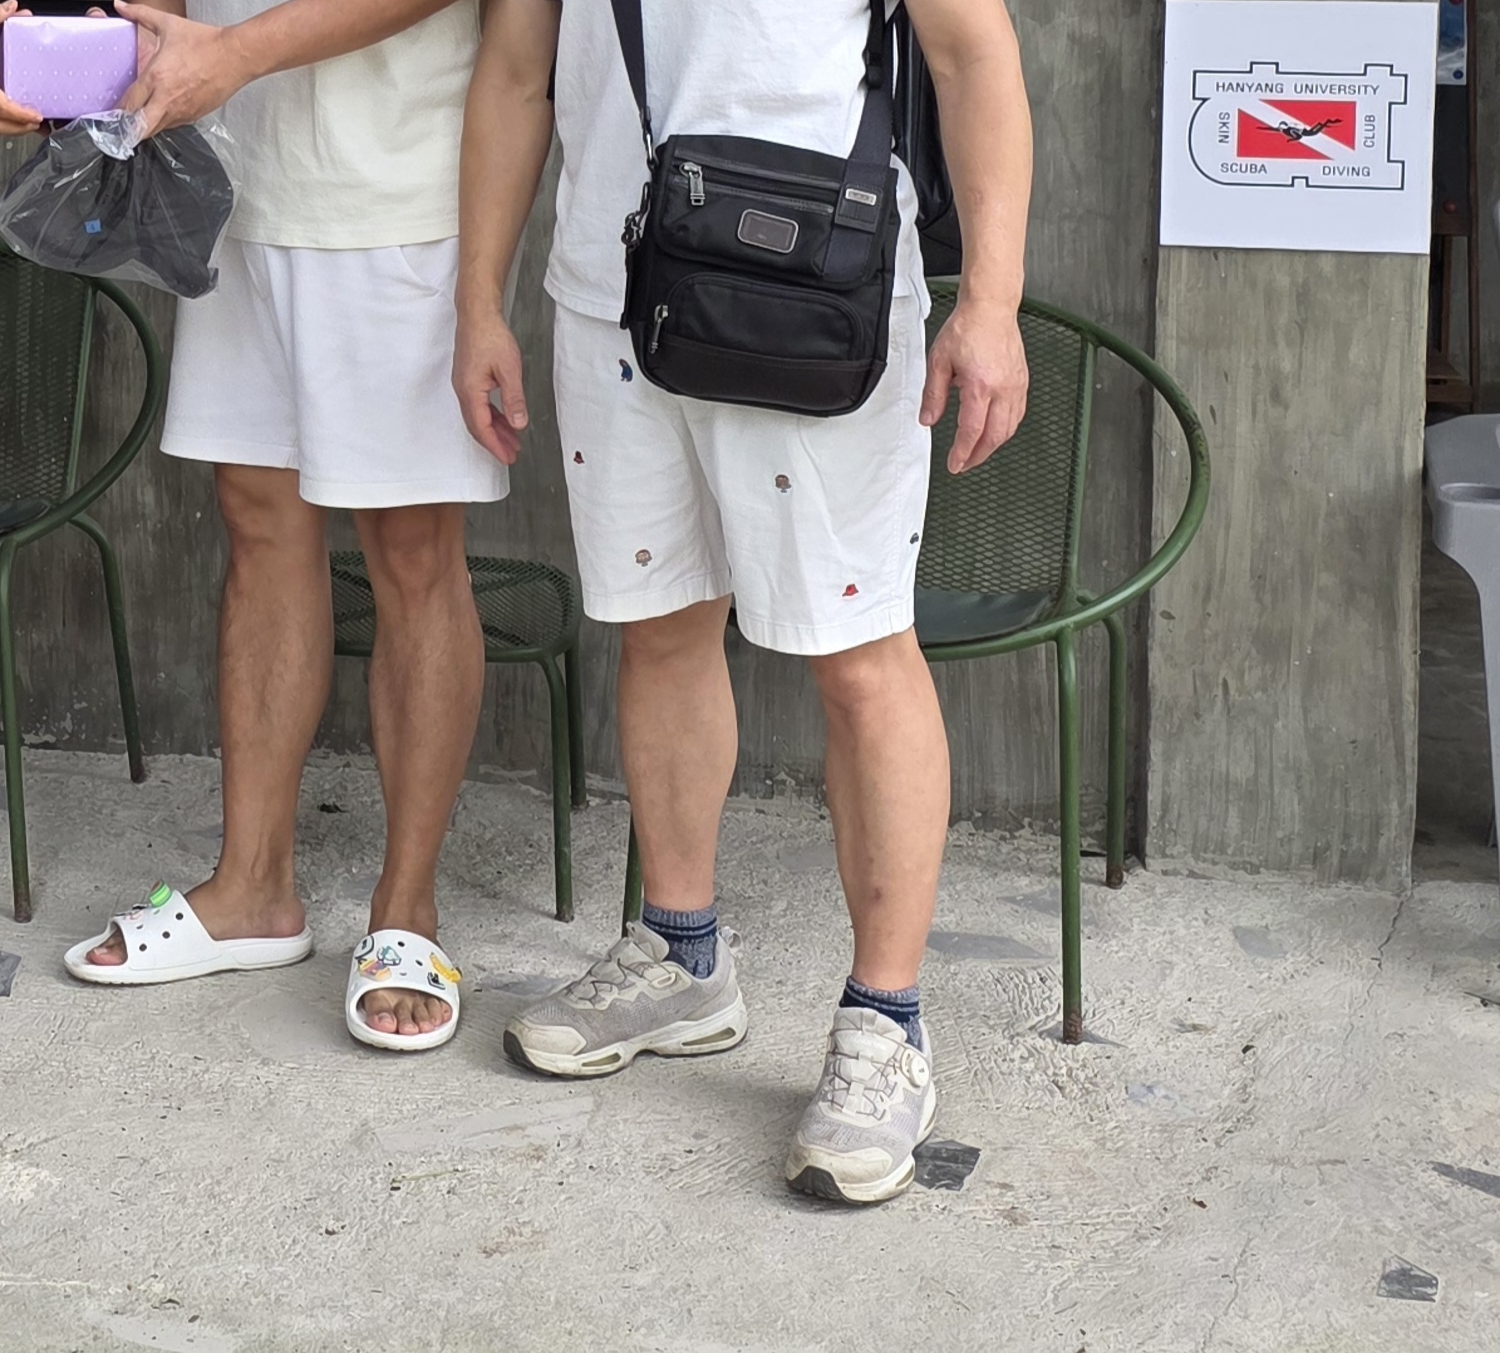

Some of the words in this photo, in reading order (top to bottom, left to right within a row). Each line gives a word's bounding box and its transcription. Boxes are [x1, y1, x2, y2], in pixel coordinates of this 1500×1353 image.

[1215, 81, 1284, 95] HANYANG
[1294, 83, 1380, 96] UNIVERSITY
[1218, 111, 1231, 144] SKIN
[1363, 114, 1376, 148] CLUB
[1220, 162, 1268, 174] SCUBA
[1322, 165, 1371, 177] DIVING
